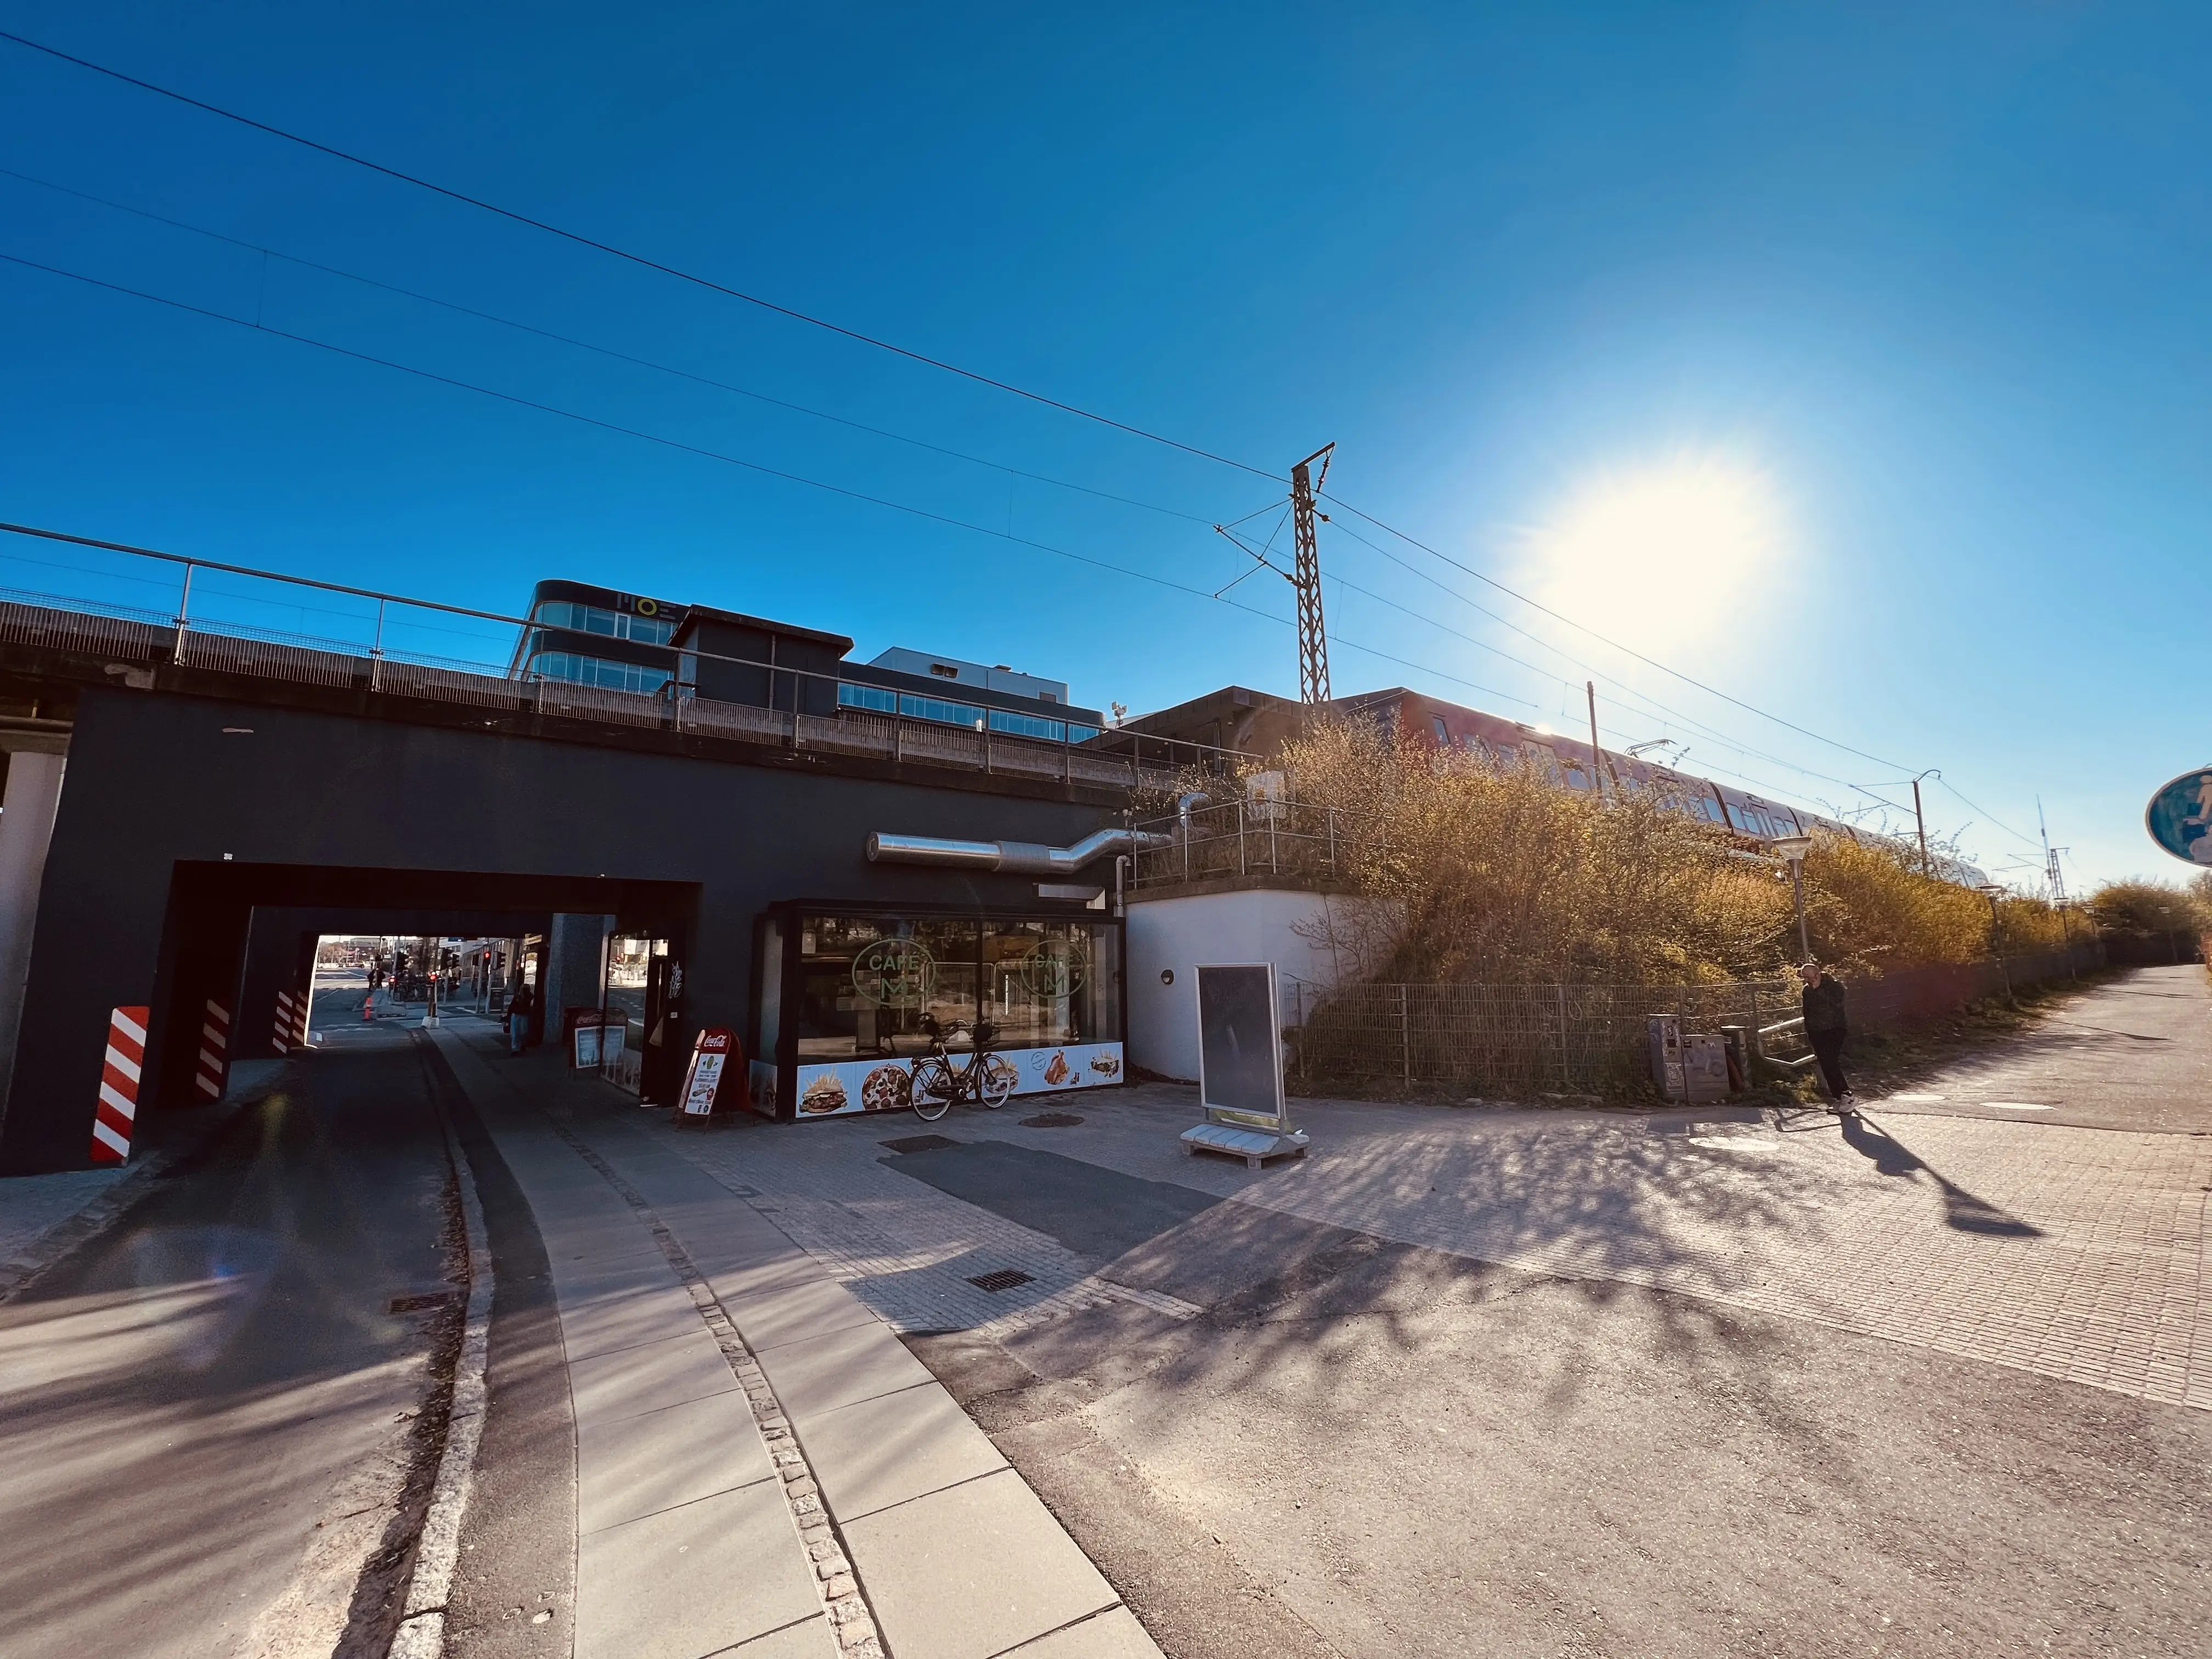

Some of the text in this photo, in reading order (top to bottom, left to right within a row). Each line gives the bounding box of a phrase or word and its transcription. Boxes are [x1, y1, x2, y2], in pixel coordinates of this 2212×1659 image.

[617, 593, 676, 619] MOE
[881, 978, 909, 999] M
[1044, 974, 1065, 994] M
